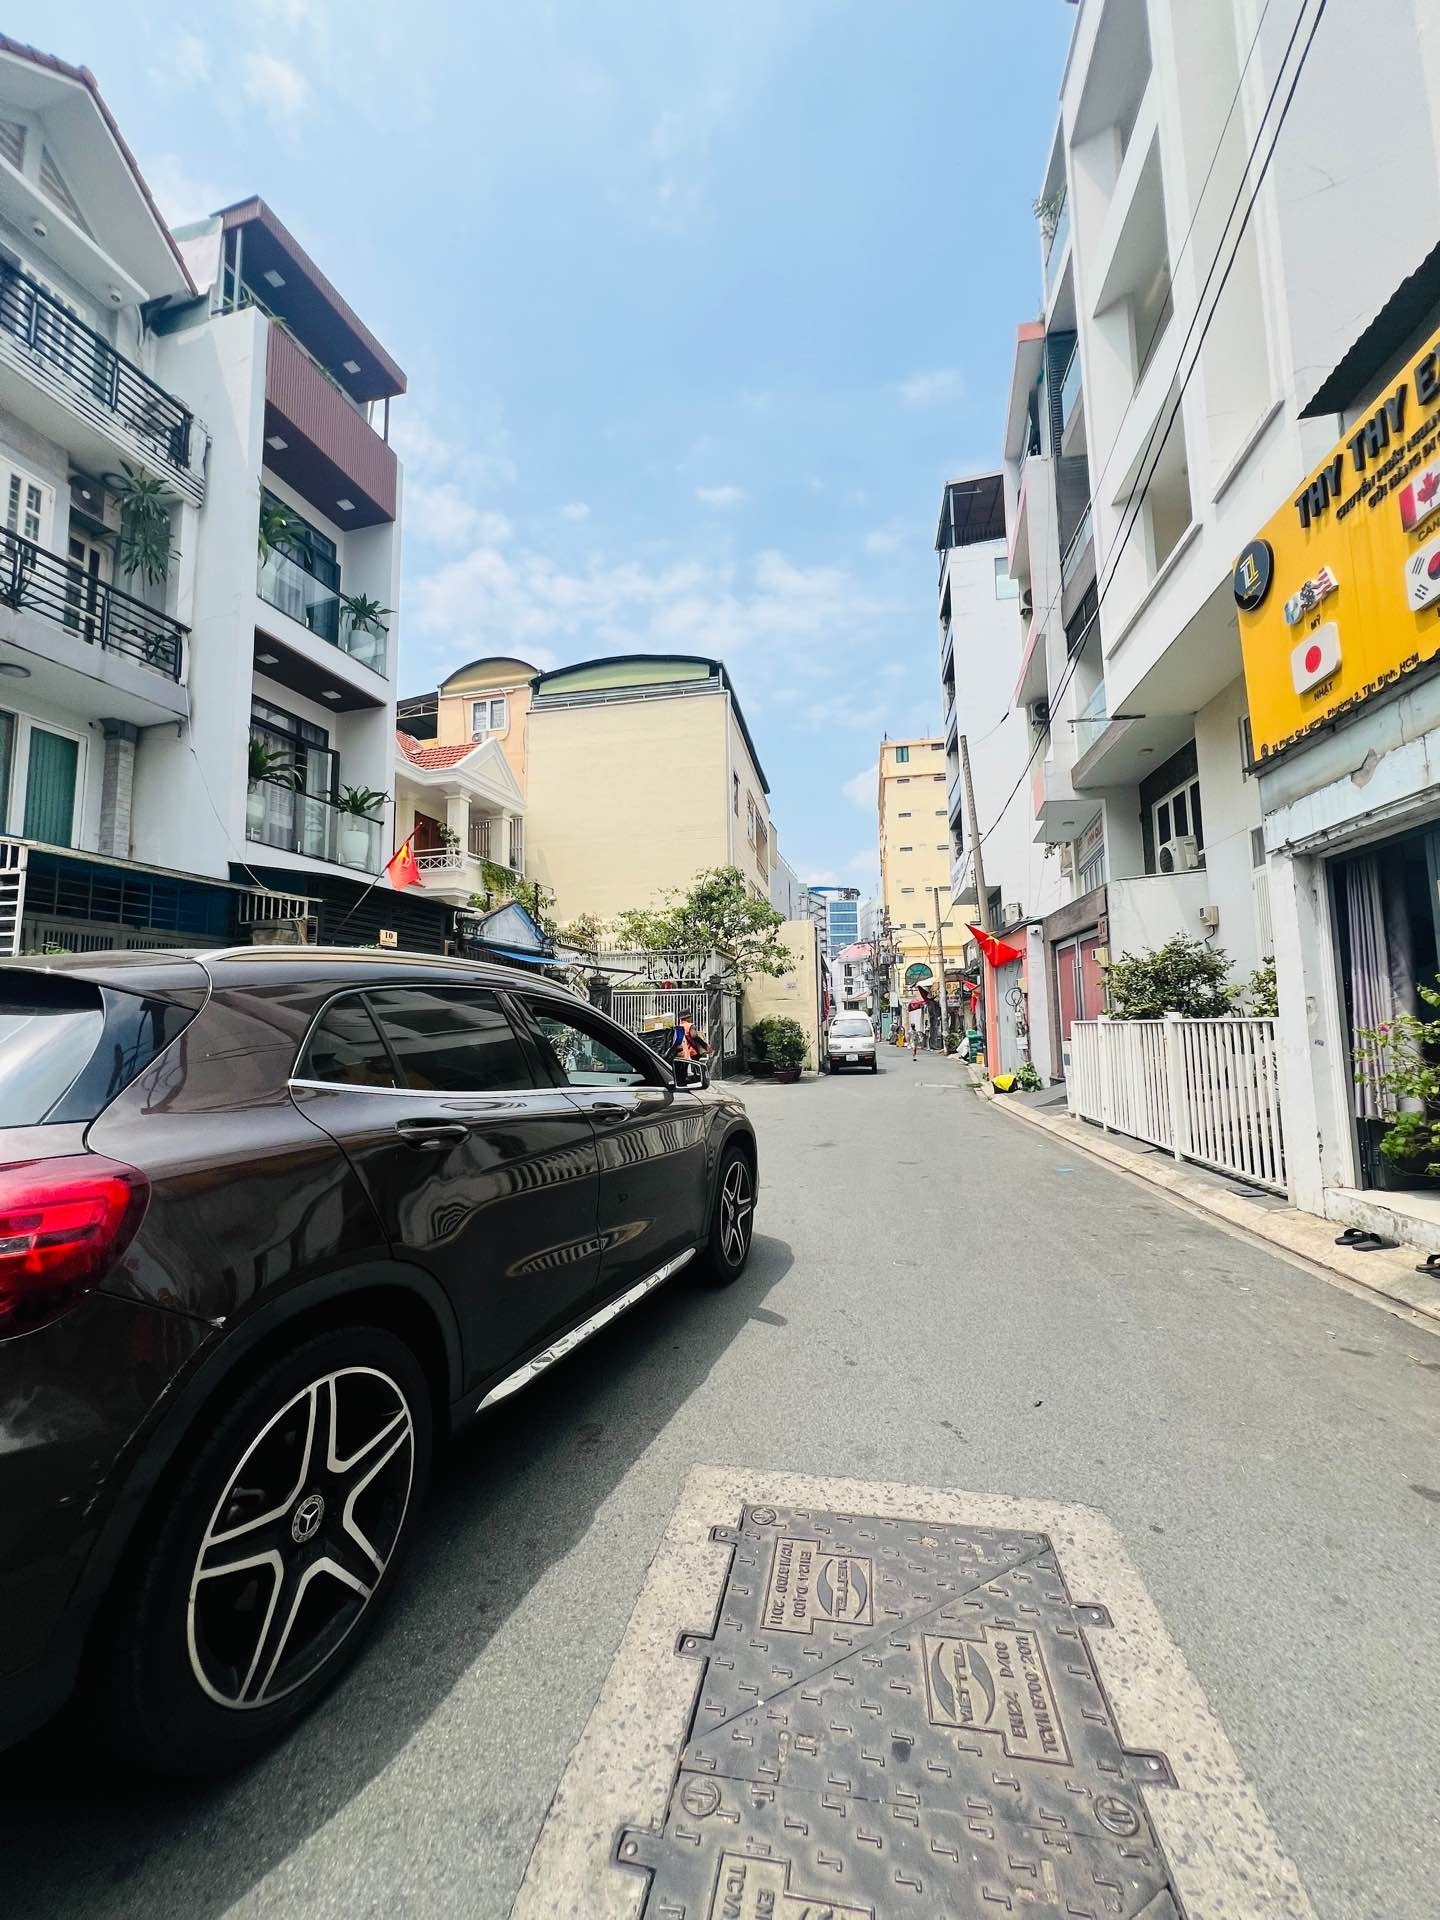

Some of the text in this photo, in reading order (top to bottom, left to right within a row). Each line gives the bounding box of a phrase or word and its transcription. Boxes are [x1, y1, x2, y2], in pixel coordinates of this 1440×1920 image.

[1295, 454, 1343, 528] THY
[1346, 384, 1408, 471] THY
[1400, 652, 1419, 671] HCM
[385, 931, 394, 940] 10
[793, 1585, 809, 1618] D400
[835, 1559, 849, 1617] VIETTEL
[953, 1642, 973, 1722] VIETTEL
[994, 1641, 1028, 1739] EN124 D400
